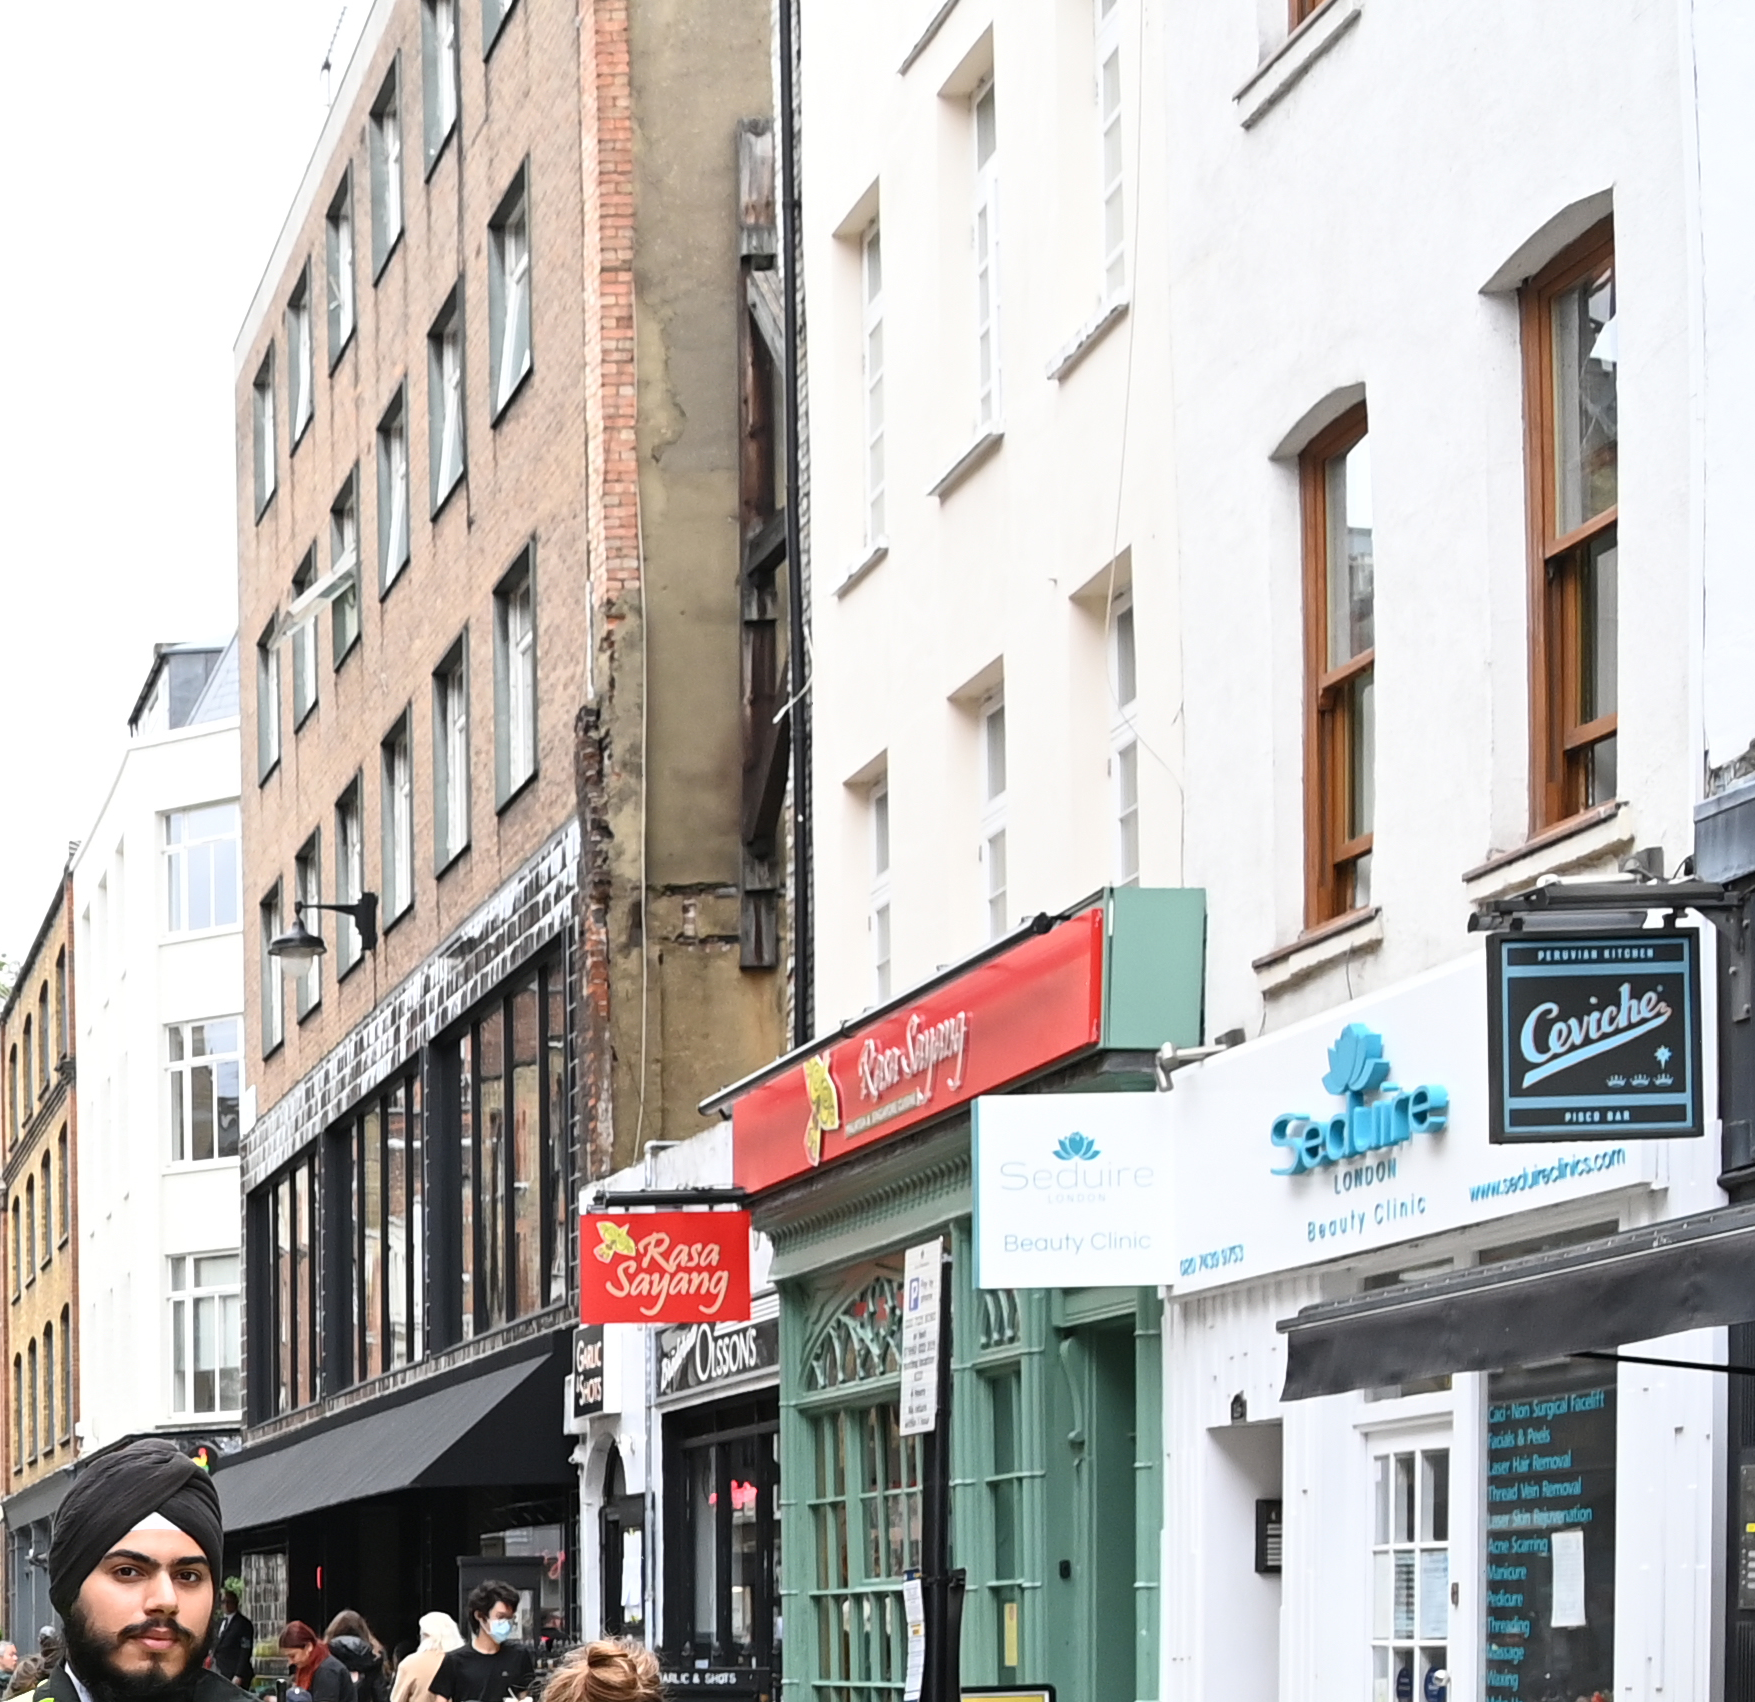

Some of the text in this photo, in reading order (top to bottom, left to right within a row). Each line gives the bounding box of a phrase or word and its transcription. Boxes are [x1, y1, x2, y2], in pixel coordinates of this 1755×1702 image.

[1537, 948, 1655, 962] PERUVIAN KITCHEN
[1520, 982, 1672, 1064] Ceviche
[858, 1038, 901, 1102] Rasa
[1270, 1081, 1450, 1176] Seduire
[1565, 1109, 1631, 1123] PISCO BAR
[1000, 1161, 1155, 1191] Seduire
[1334, 1158, 1398, 1195] LONDON
[1047, 1192, 1107, 1205] LONDON
[1307, 1193, 1427, 1243] Beauty Clinic
[638, 1231, 721, 1274] Rasa
[1003, 1231, 1152, 1256] Beauty Clinic
[605, 1259, 730, 1317] Sayang
[659, 1671, 690, 1685] ARLIC
